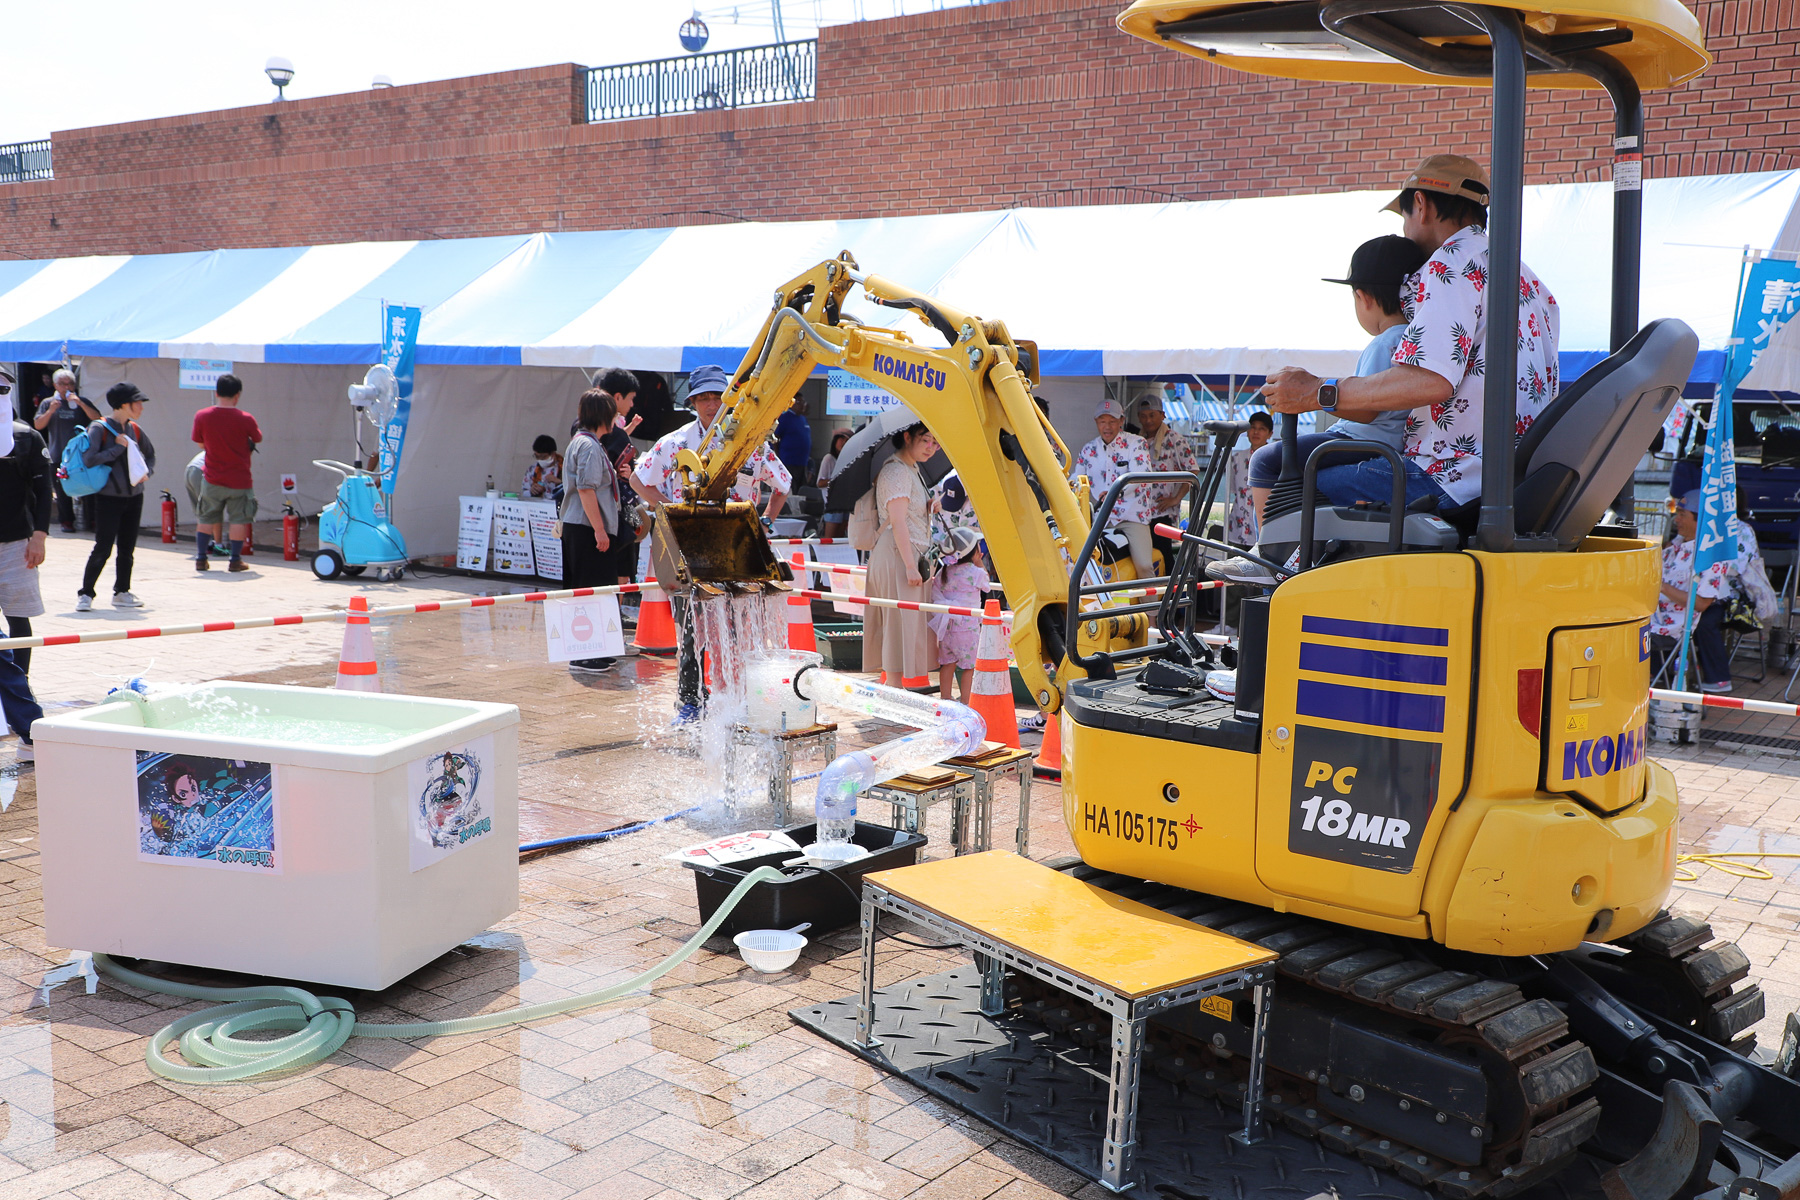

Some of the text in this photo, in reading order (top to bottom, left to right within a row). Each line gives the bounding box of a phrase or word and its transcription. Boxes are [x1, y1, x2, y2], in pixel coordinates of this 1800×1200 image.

[873, 353, 946, 391] KOMATSU
[1562, 722, 1648, 780] KOMA
[1304, 760, 1358, 795] PC
[1300, 795, 1411, 849] 18MR
[218, 847, 274, 868] 水の呼吸
